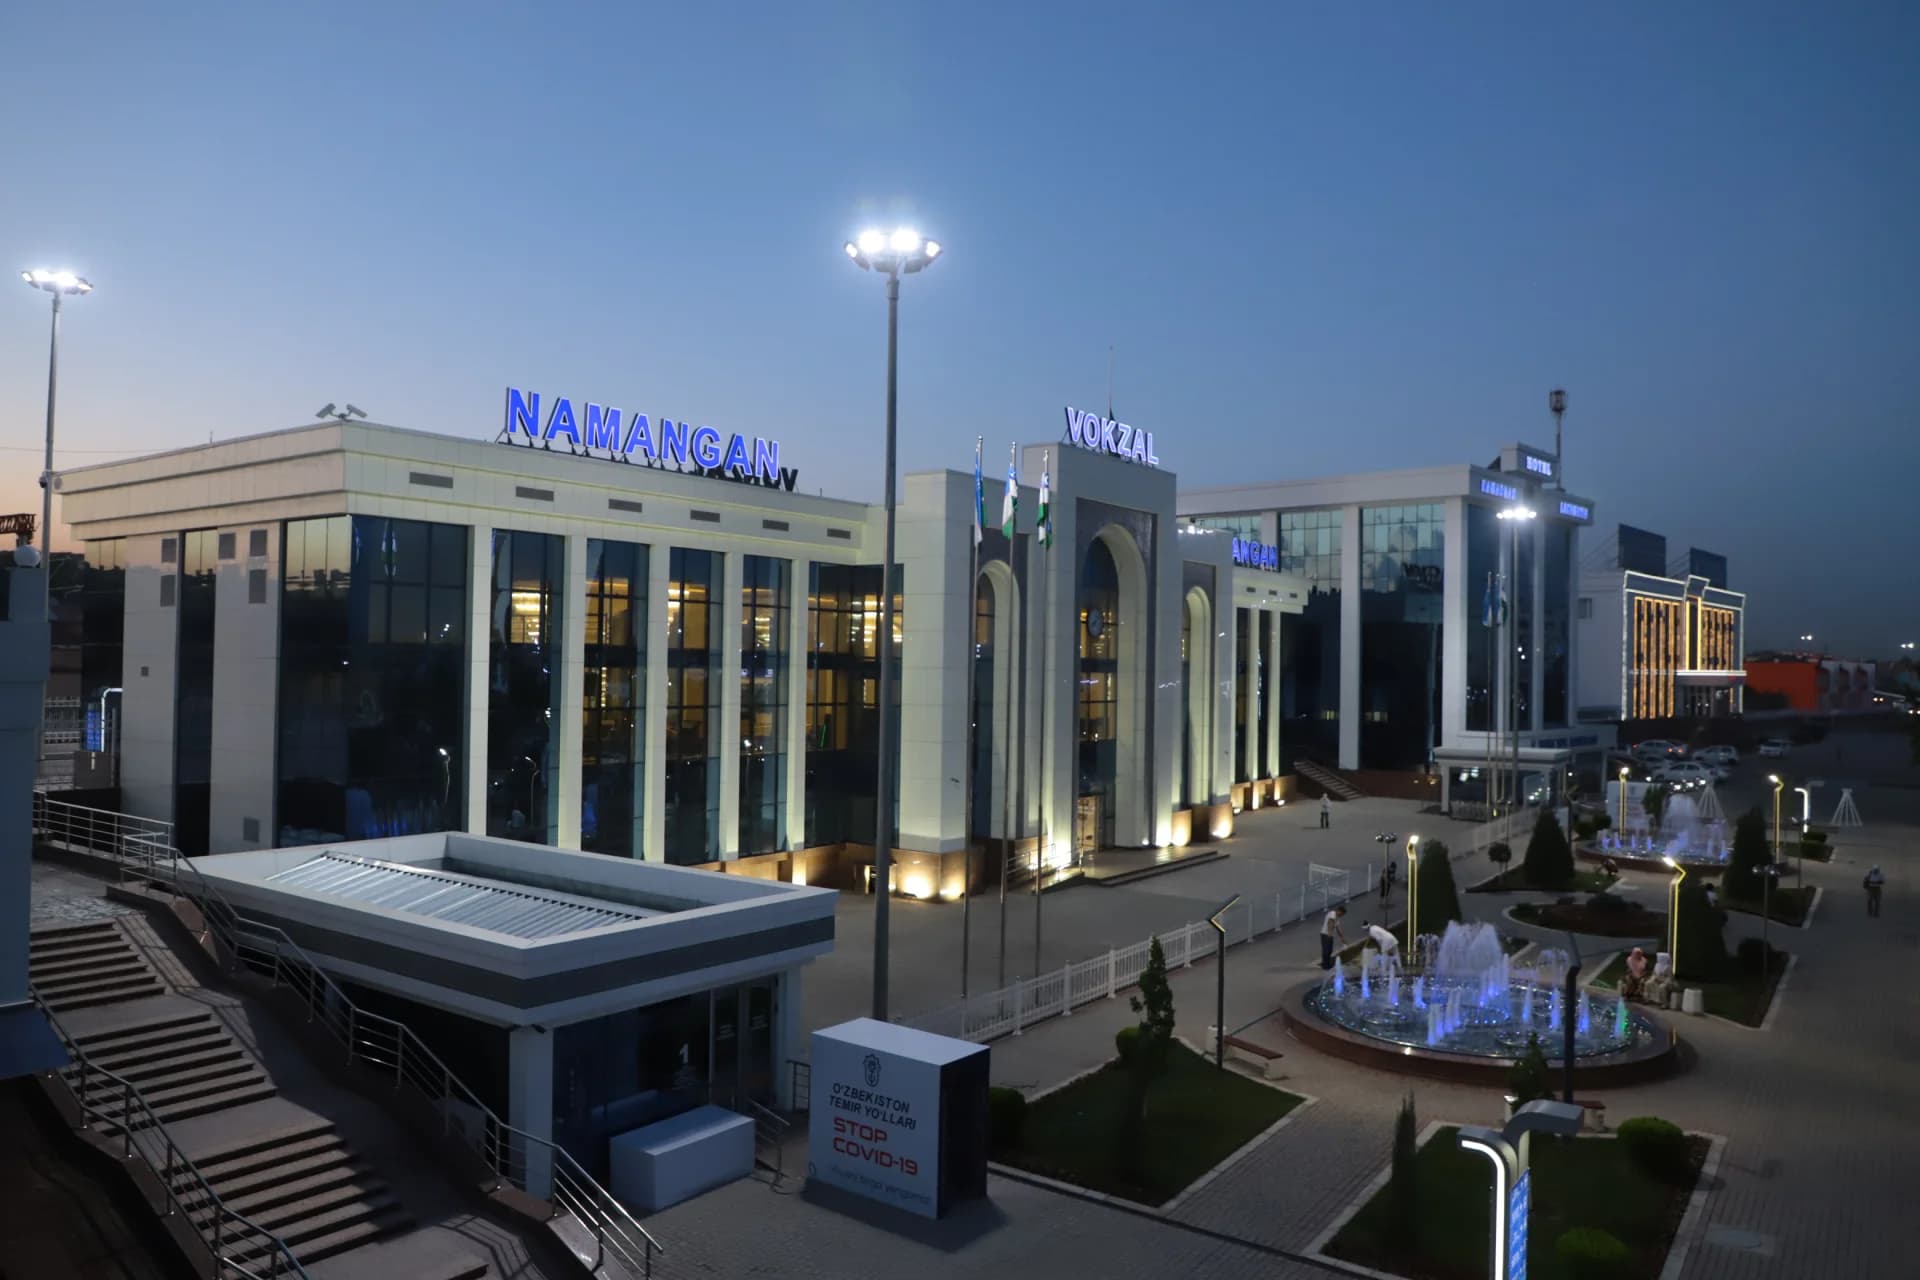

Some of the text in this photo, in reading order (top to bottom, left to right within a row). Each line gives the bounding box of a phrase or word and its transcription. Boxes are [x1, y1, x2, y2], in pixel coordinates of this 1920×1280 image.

[507, 386, 780, 480] NAMANGAN
[1065, 406, 1159, 465] VOKZAL
[829, 1095, 917, 1130] TEMIR YO'LLARI
[832, 1082, 910, 1114] O'ZBEKISTON
[833, 1116, 888, 1144] STOP
[832, 1137, 918, 1176] COVID-19
